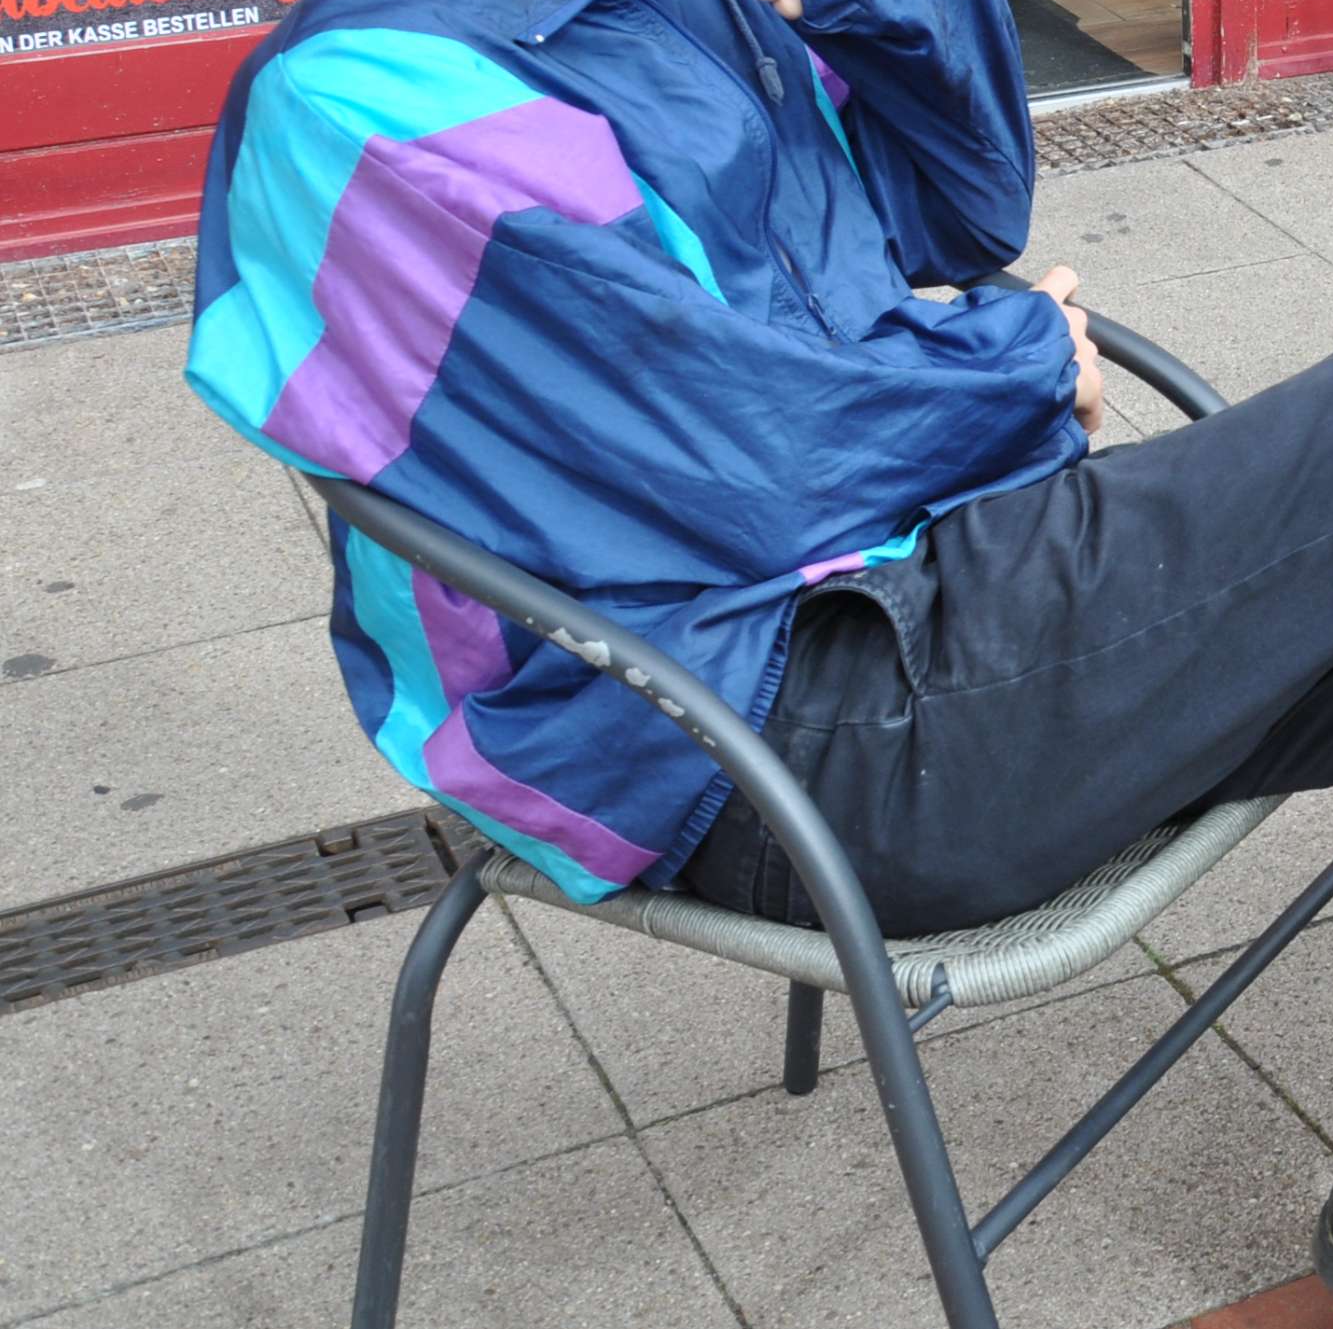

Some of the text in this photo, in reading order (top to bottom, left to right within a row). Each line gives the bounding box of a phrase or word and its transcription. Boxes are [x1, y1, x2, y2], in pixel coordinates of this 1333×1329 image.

[19, 30, 64, 51] DER
[69, 21, 139, 46] KASSE
[143, 6, 259, 37] BESTELLEN
